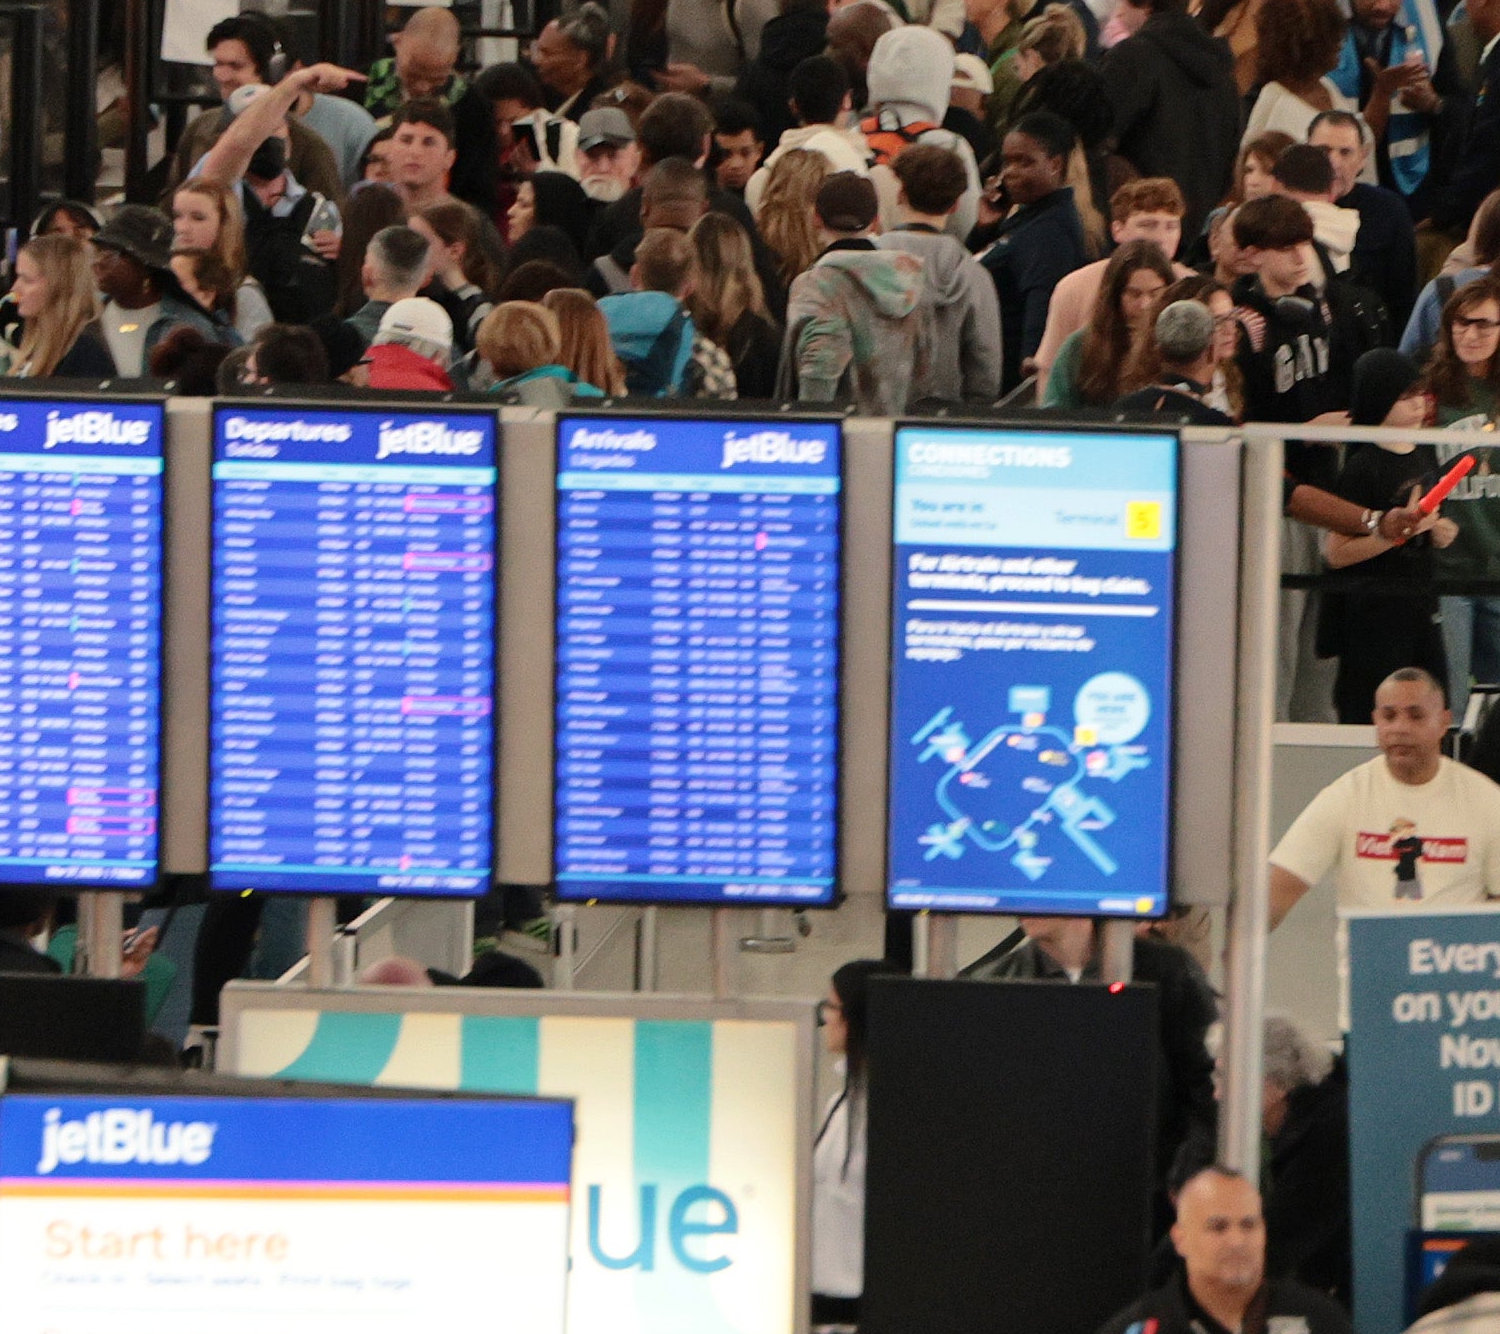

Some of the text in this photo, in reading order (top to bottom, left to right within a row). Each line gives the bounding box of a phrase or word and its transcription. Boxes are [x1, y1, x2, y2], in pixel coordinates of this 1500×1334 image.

[43, 410, 152, 449] jetBlue
[225, 417, 485, 460] Departures jetBlue
[569, 428, 828, 469] Arrivals jetBlue
[907, 442, 1073, 469] CONNECTIONS
[1393, 992, 1441, 1022] on
[1454, 1081, 1493, 1116] ID
[37, 1107, 217, 1174] jetBlue
[43, 1219, 290, 1264] Start here
